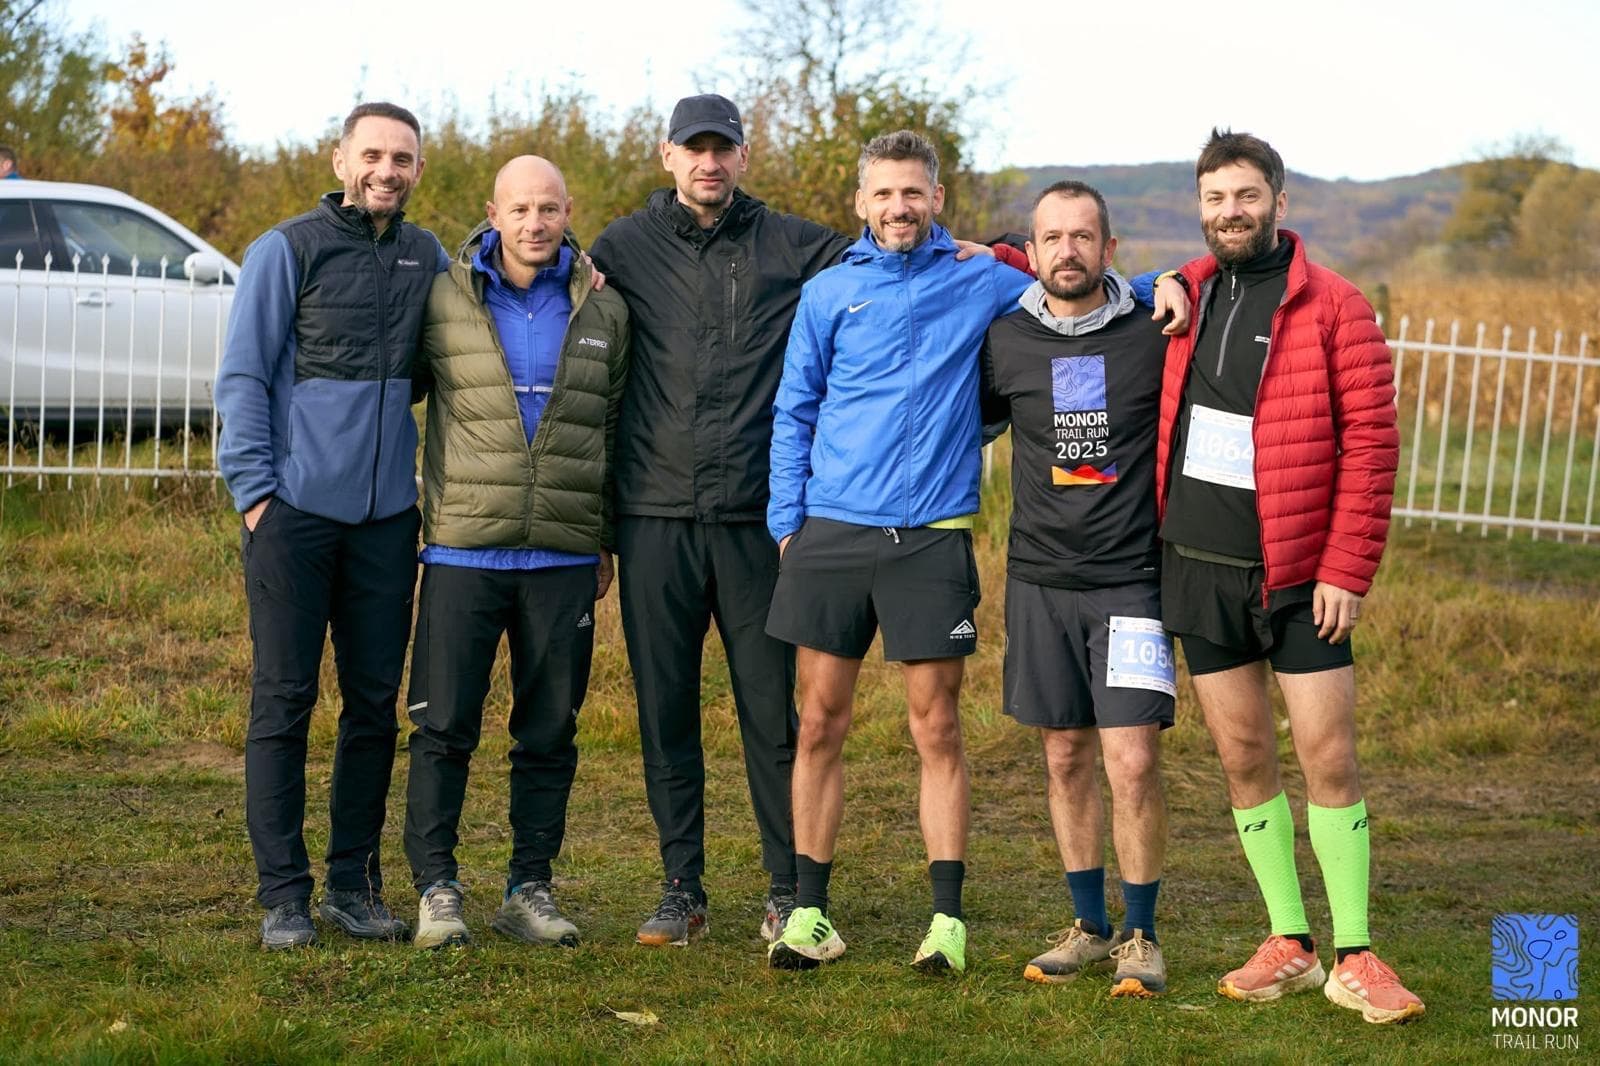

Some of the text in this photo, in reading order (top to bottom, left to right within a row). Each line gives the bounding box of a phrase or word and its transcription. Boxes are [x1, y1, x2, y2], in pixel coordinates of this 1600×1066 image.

[1054, 411, 1108, 427] MONOR
[1055, 427, 1109, 439] TRAIL RUN
[1055, 440, 1108, 459] 2025
